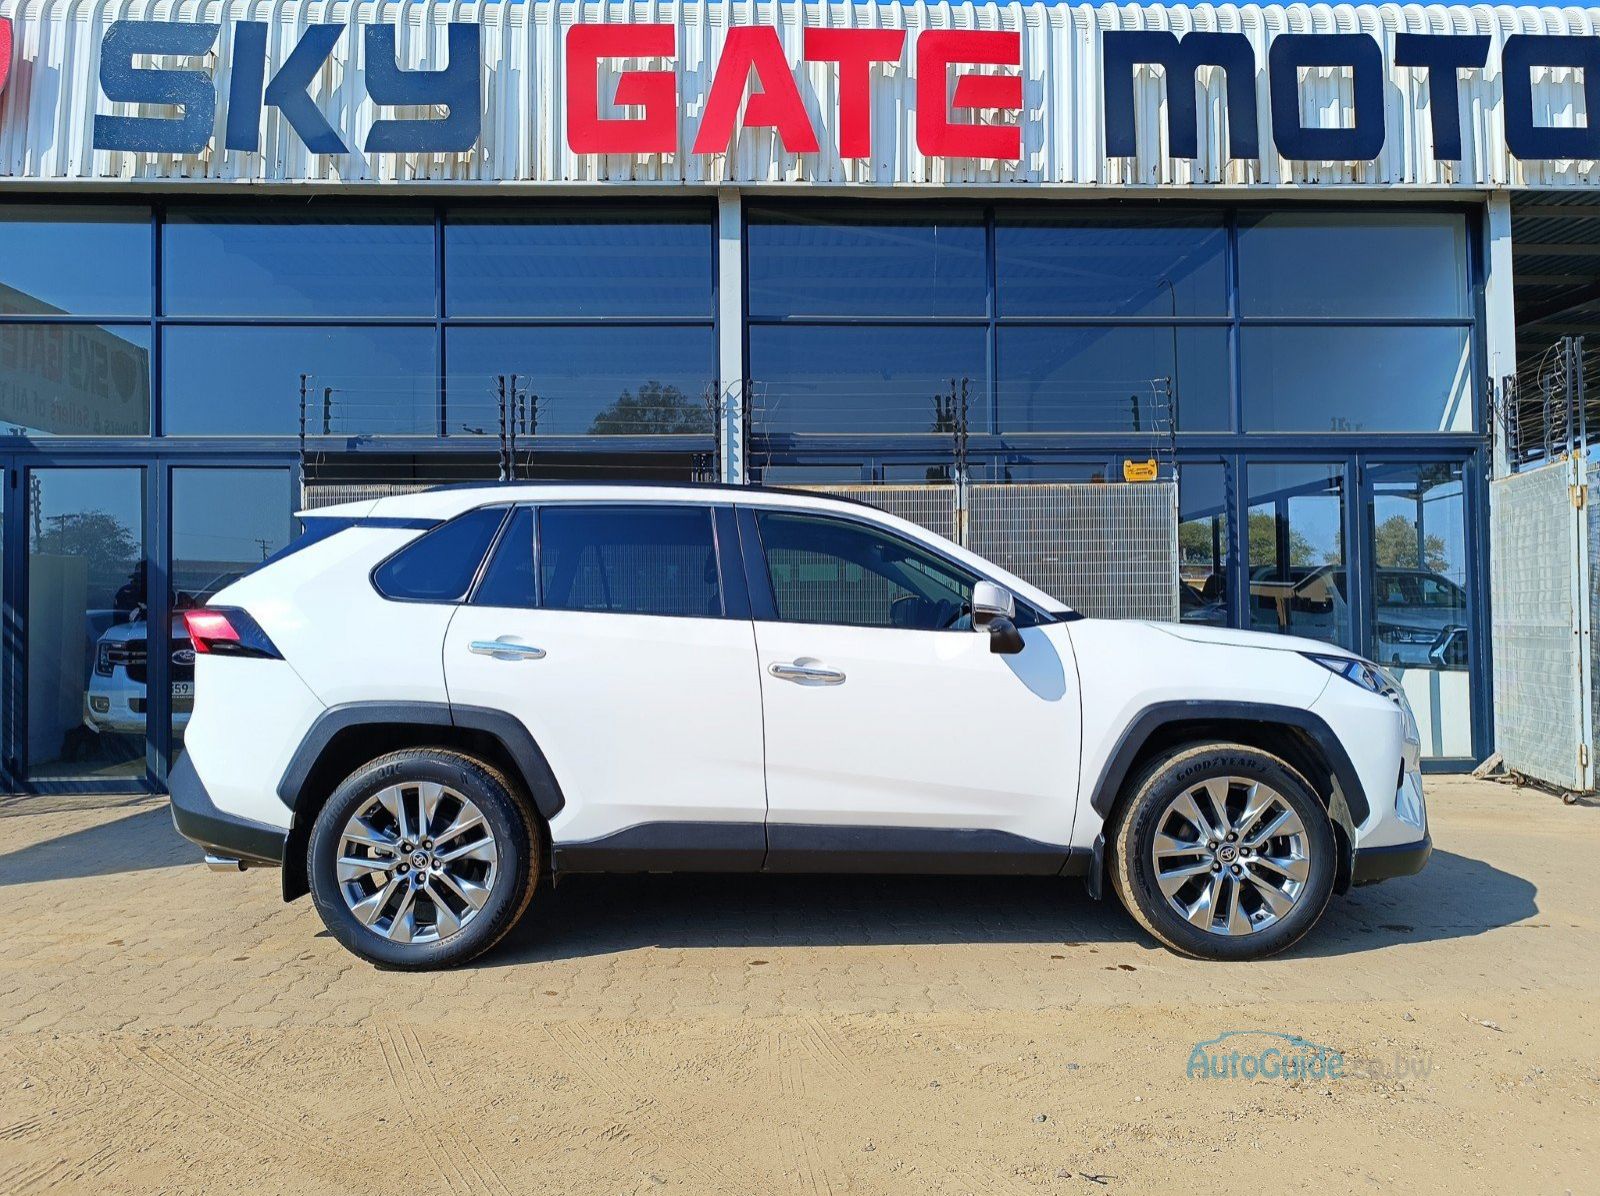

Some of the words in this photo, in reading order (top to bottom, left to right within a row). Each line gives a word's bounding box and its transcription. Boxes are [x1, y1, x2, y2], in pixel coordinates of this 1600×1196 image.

[93, 20, 481, 155] SKY
[566, 24, 1023, 161] GATE
[172, 683, 189, 694] 59
[1176, 757, 1257, 781] GOODYEAR
